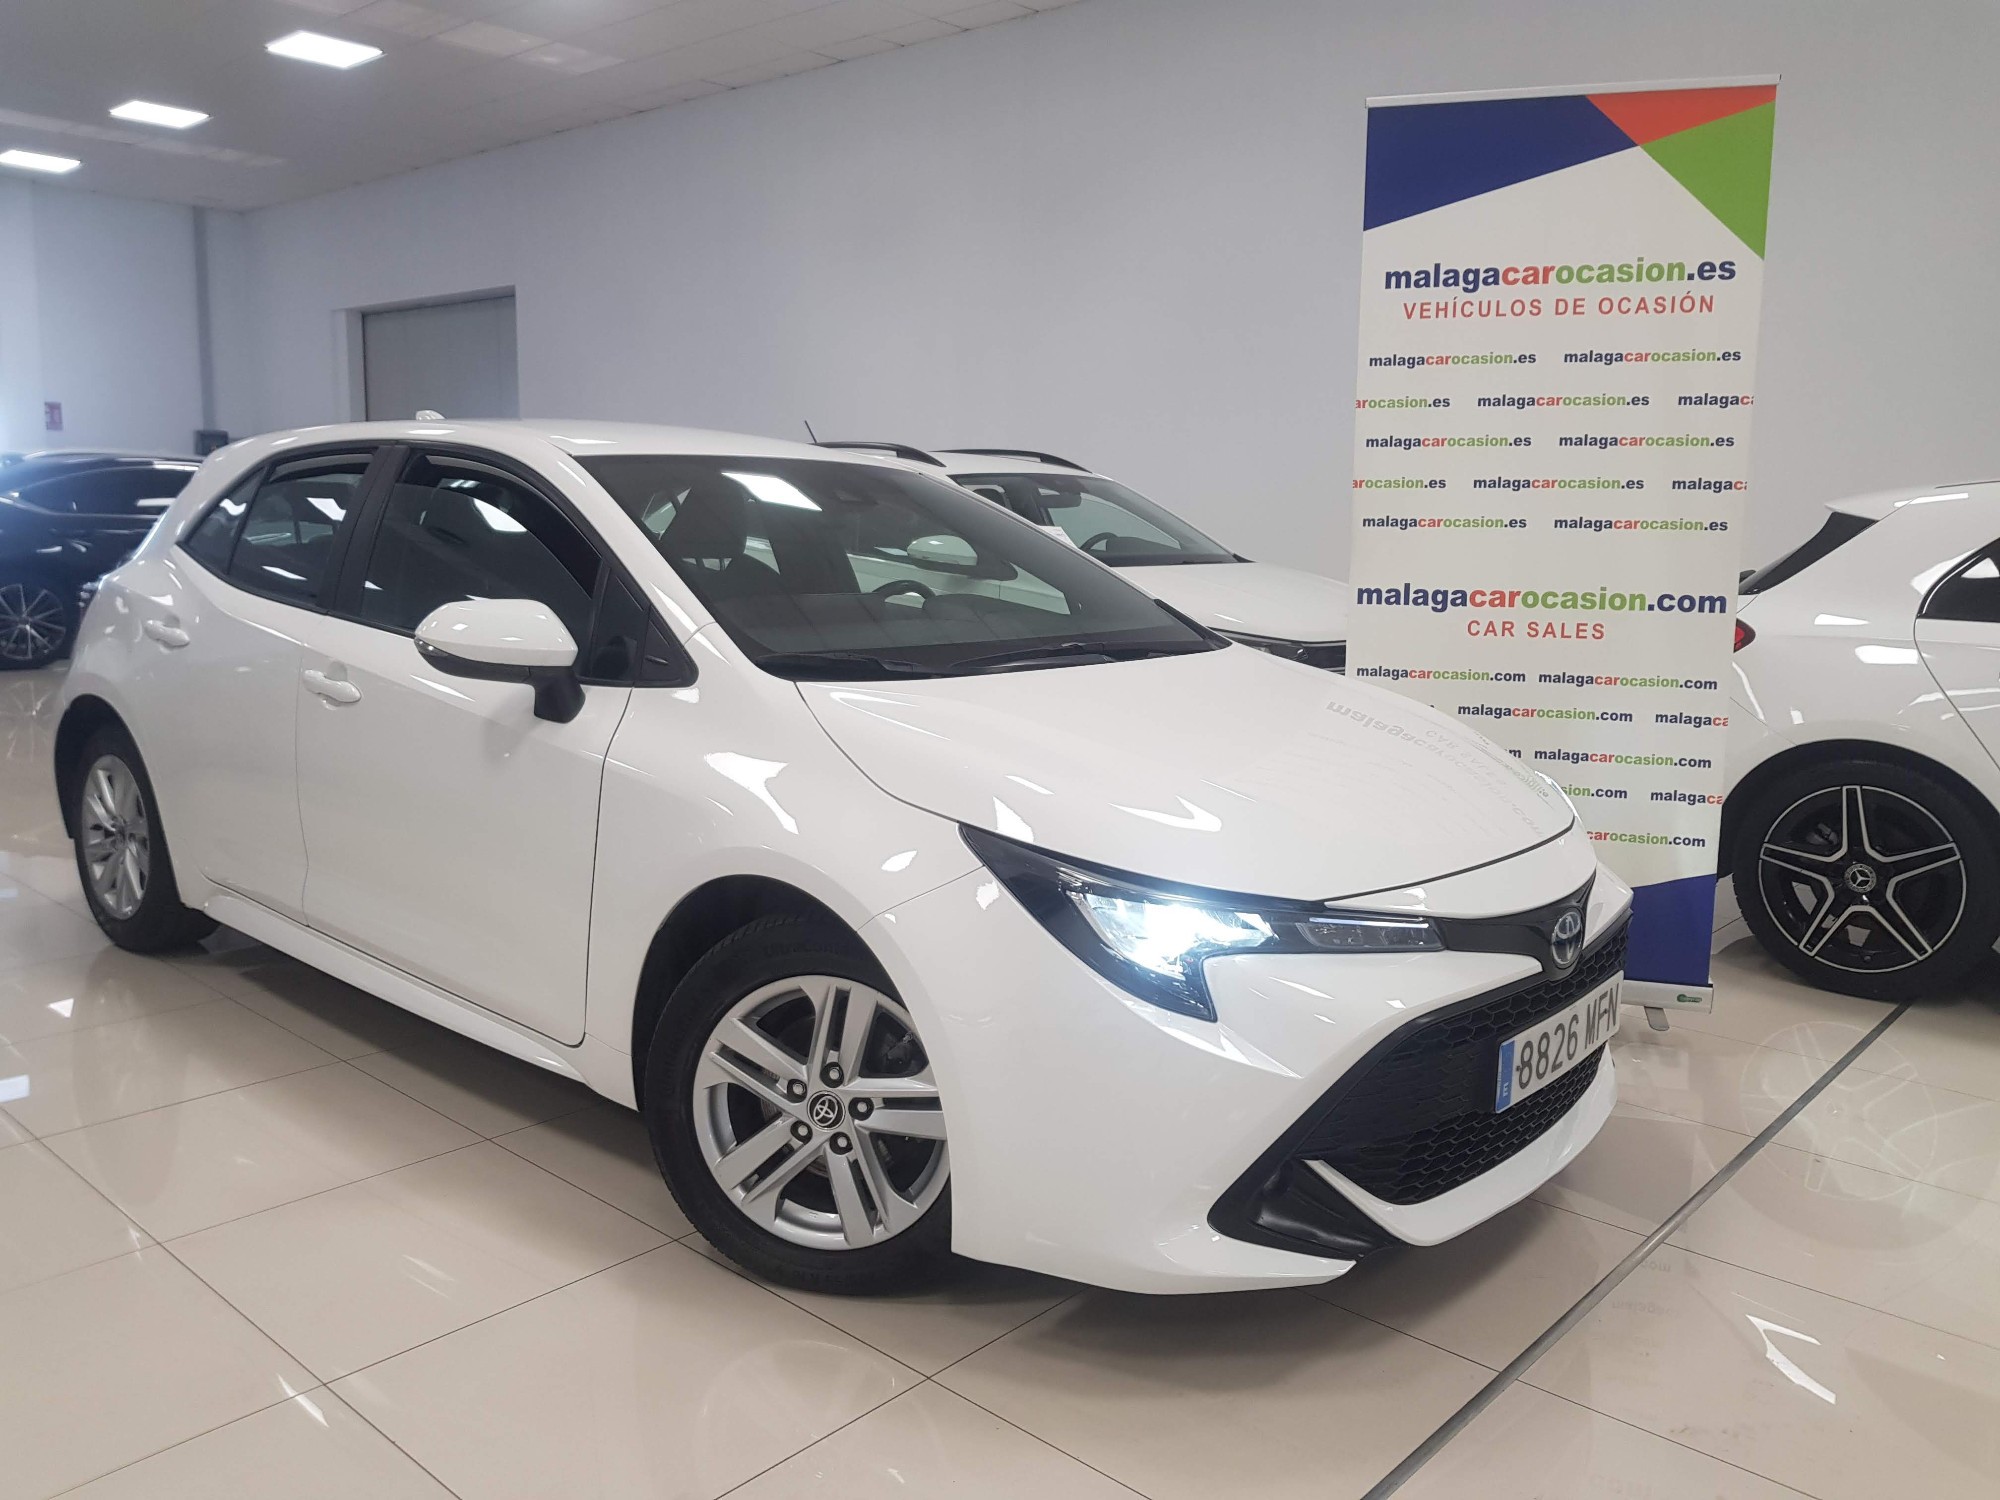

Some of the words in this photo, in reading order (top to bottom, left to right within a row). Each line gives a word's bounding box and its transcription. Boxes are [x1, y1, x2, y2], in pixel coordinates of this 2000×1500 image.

[1385, 257, 1736, 292] malagacarocasion.es
[1404, 296, 1541, 319] VEHÍCULOS
[1555, 298, 1585, 315] DE
[1599, 291, 1713, 314] OCASIÓN
[1370, 352, 1536, 369] malagacarocasion.es
[1564, 349, 1741, 365] malagacarocasion.es
[1478, 394, 1649, 409] malagacarocasion.es
[1366, 435, 1531, 450] malagacarocasion.es
[1559, 434, 1734, 449] malagacarocasion.es
[1474, 477, 1644, 491] malagacarocasion.es
[1363, 515, 1527, 530] malagacarocasion.es
[1554, 517, 1728, 532] malagacarocasion.es
[1357, 583, 1726, 613] malagacarocasion.com
[1468, 620, 1514, 637] CAR
[1527, 622, 1604, 639] SALES
[1357, 666, 1525, 682] malagacarocasion.com
[1539, 672, 1717, 690] malagacarocasion.com
[1458, 704, 1632, 722] malagacarocasion.com
[1535, 749, 1711, 768] malagacarocasion.com
[1518, 1014, 1580, 1090] 8826
[1585, 982, 1620, 1050] MFN
[1503, 1082, 1509, 1098] E
